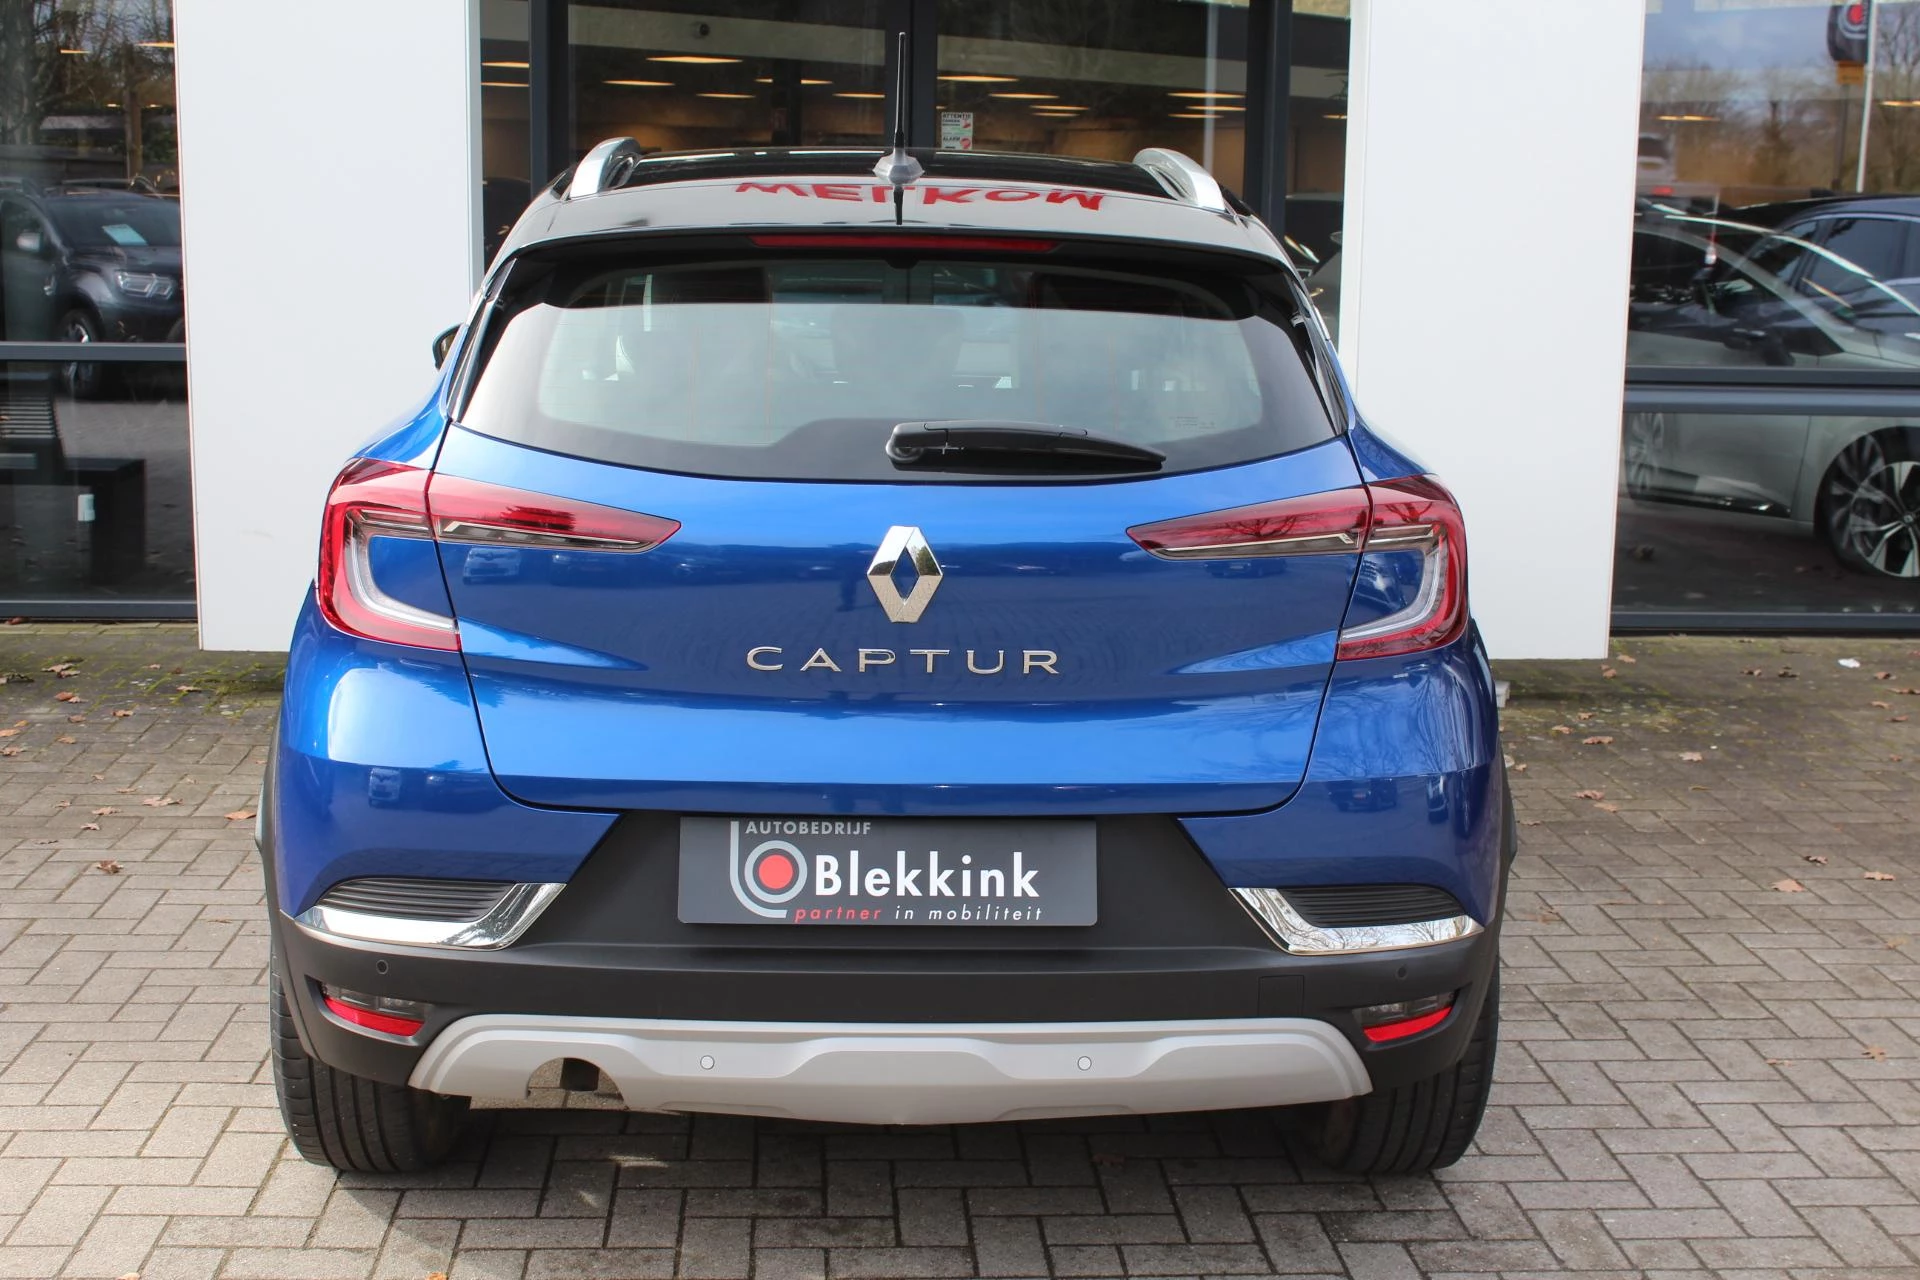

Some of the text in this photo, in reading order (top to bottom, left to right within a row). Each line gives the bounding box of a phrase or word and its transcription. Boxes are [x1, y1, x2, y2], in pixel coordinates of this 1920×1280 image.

[746, 646, 1059, 675] CAPTUR
[745, 821, 872, 836] AUTOBEDRIJF
[815, 850, 1040, 897] Blekkink
[793, 903, 1042, 924] partner in mobiliteit
